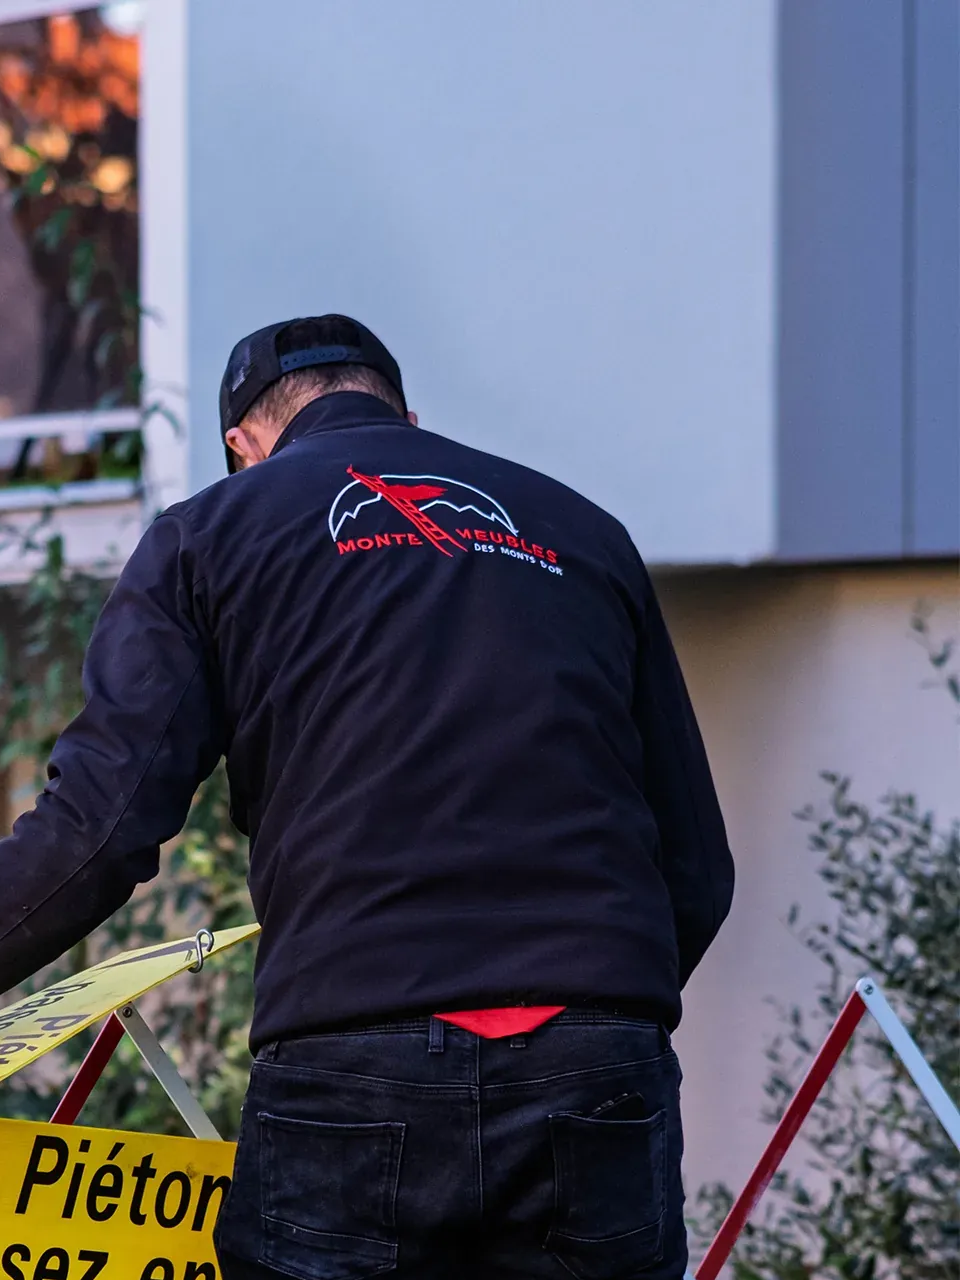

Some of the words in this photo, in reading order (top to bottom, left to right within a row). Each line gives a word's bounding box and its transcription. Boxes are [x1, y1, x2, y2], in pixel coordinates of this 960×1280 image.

[336, 532, 423, 555] MONTE
[455, 528, 558, 564] MEUBLES
[473, 542, 495, 553] DES
[500, 546, 536, 564] MONTS
[15, 1134, 232, 1232] Piéton
